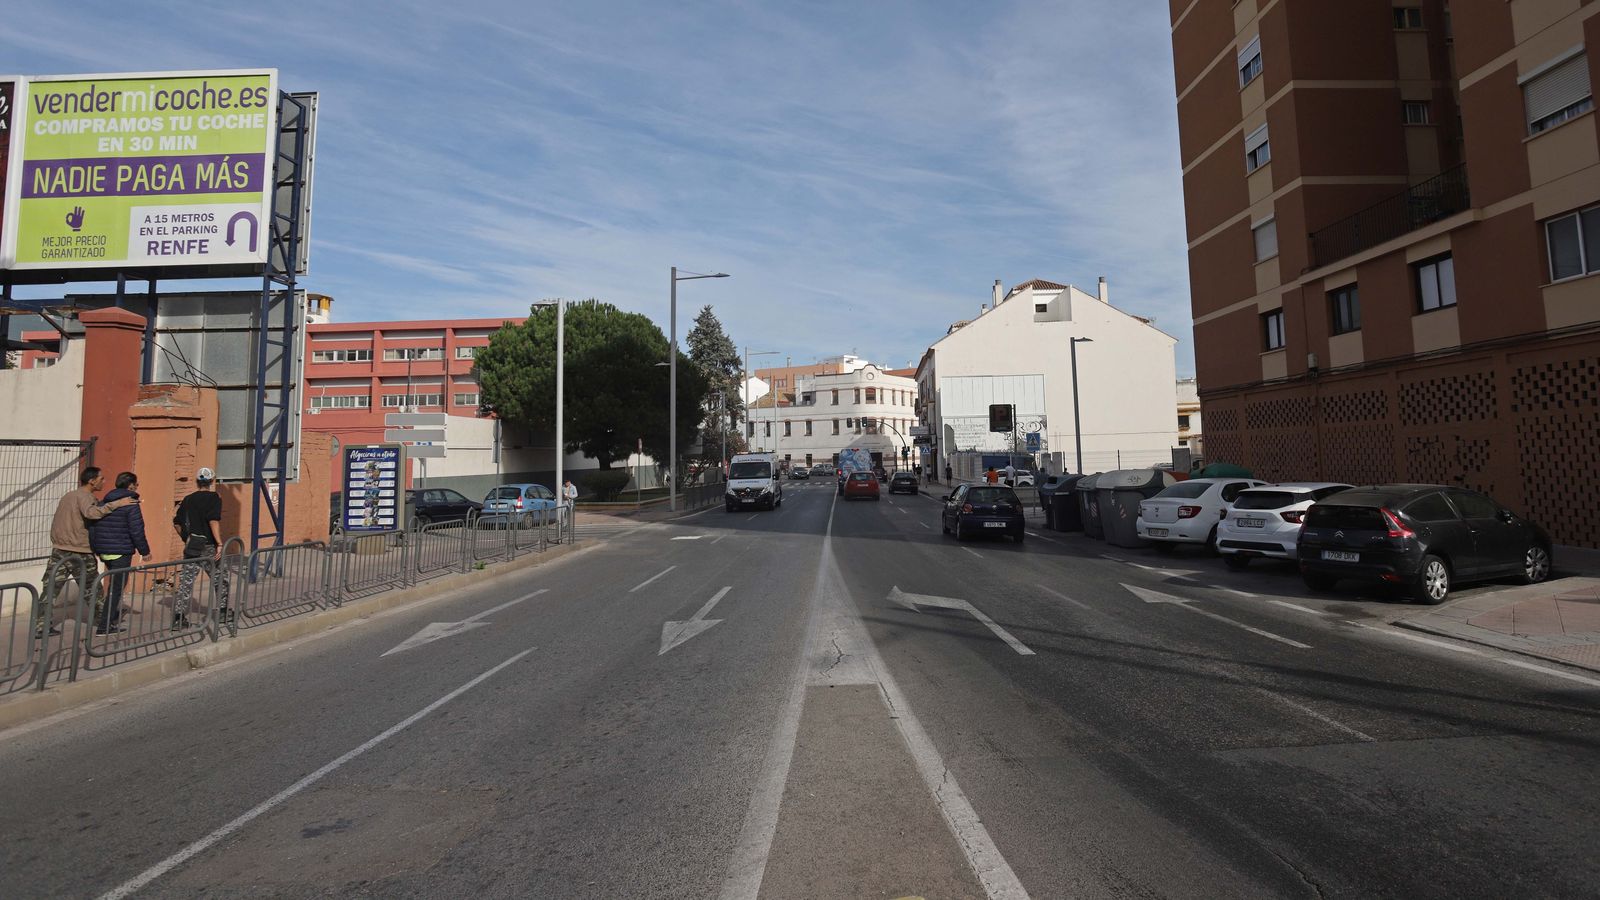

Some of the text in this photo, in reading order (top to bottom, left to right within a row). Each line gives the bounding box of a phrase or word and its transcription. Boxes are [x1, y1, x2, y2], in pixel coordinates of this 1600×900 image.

[34, 81, 268, 114] vendermicoche.es
[34, 113, 265, 135] COMPRAMOS TU COCHE
[97, 135, 198, 152] EN 30 MIN
[33, 155, 249, 194] NADIE PAGA MÁS
[144, 212, 215, 224] A 15 METROS
[139, 225, 218, 236] EN EL PARKING
[42, 235, 107, 247] MEJOR PRECIO
[146, 239, 210, 256] RENFE
[41, 247, 106, 259] GARANTIZADO
